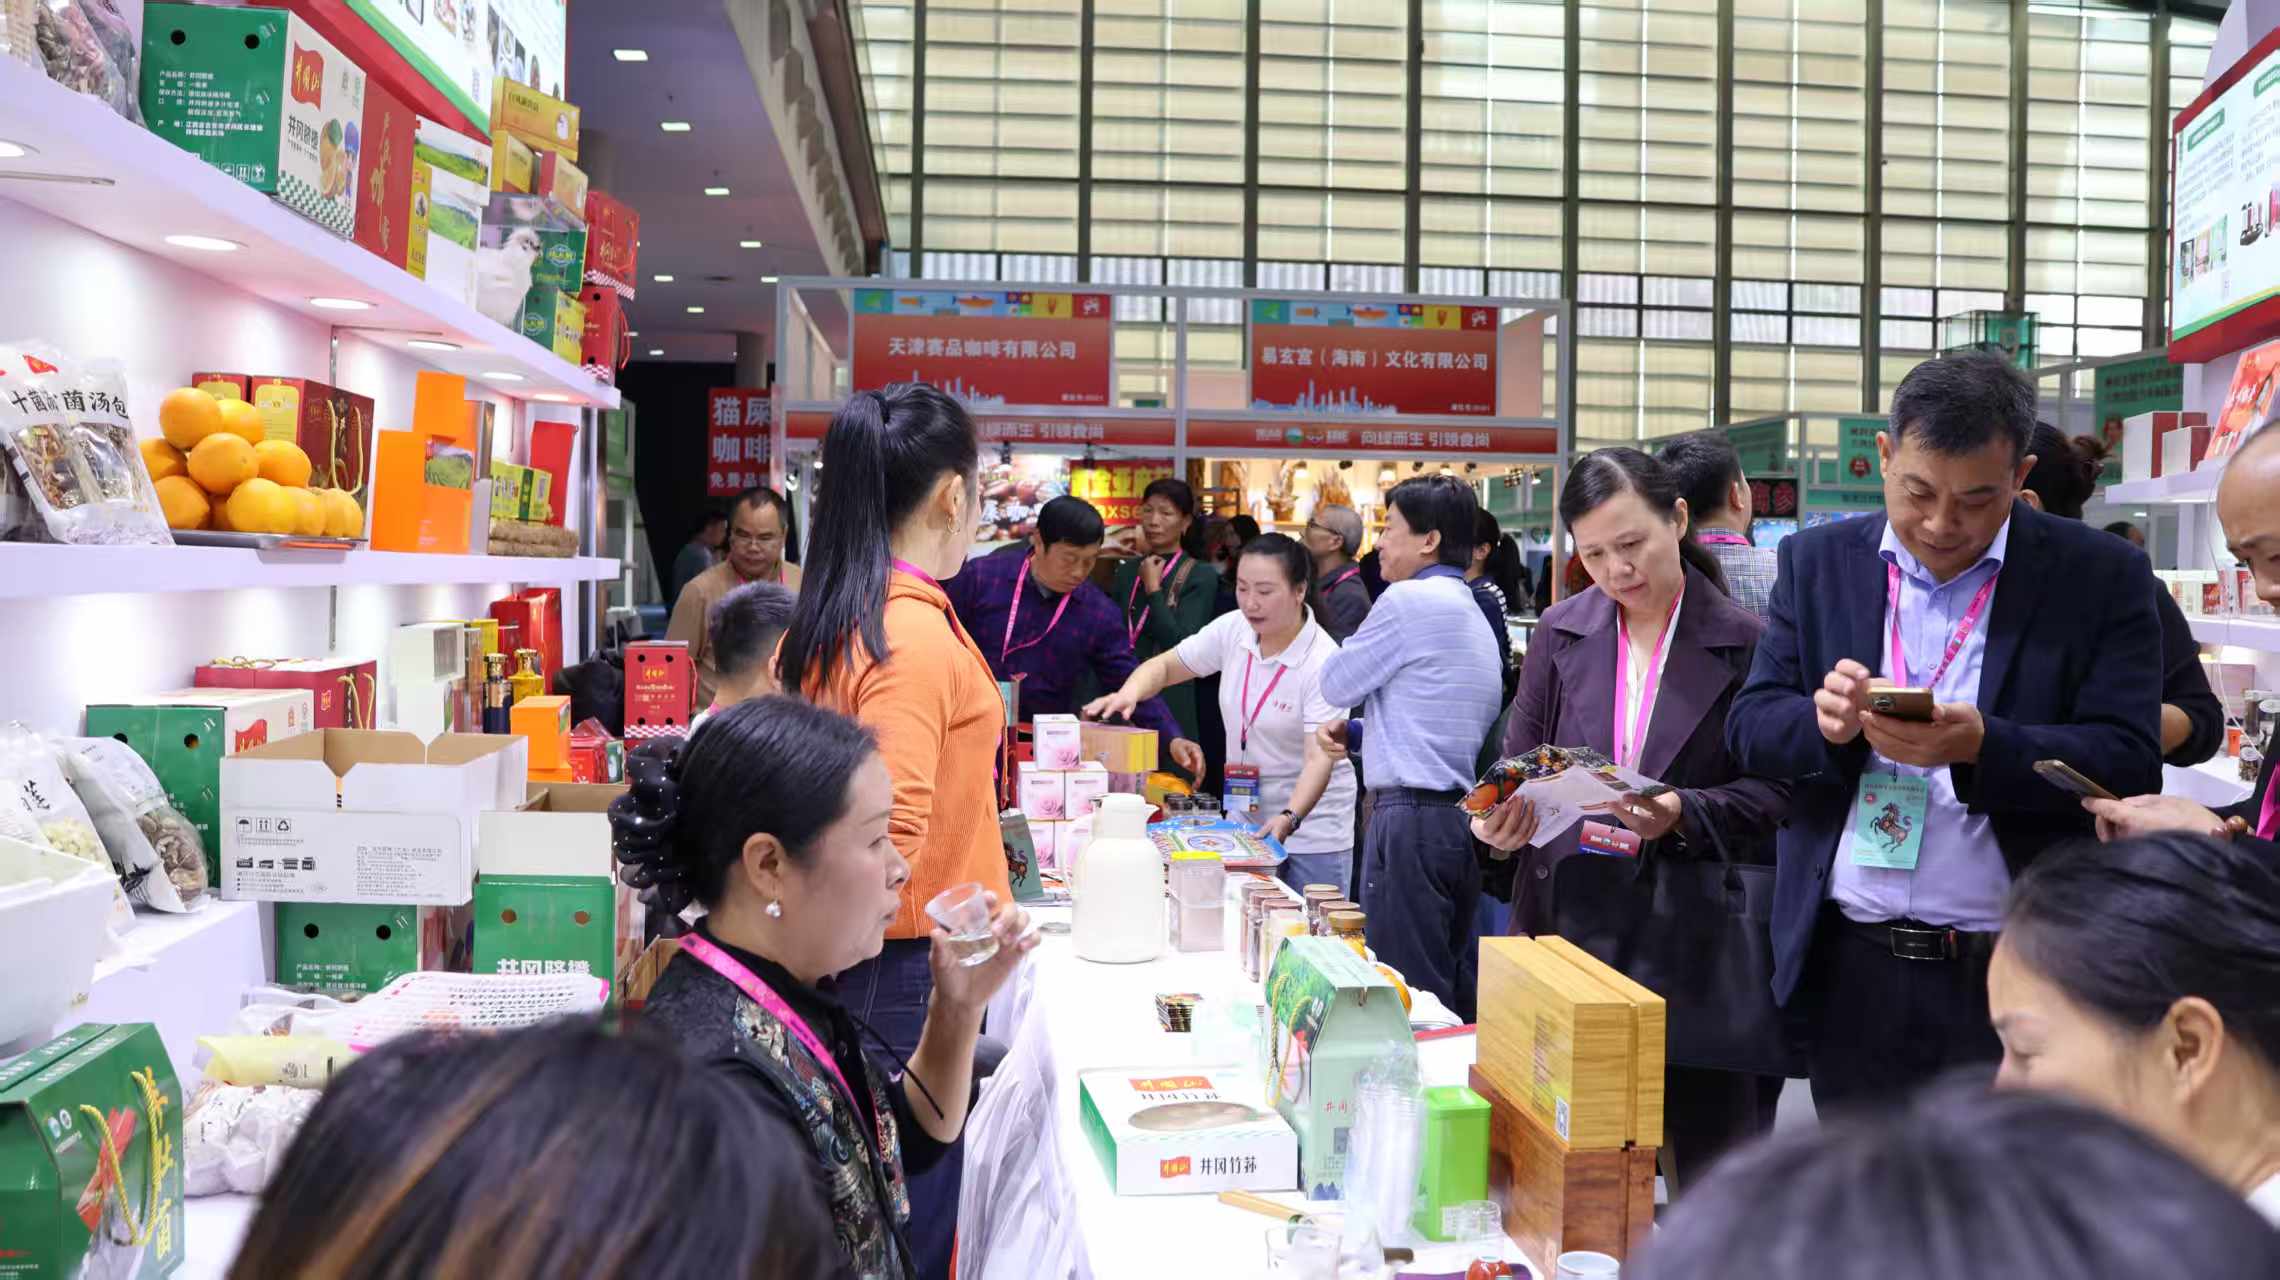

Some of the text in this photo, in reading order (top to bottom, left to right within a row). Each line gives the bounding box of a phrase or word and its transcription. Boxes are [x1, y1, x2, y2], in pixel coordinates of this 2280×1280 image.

[713, 434, 770, 464] 咖啡
[1200, 1157, 1257, 1176] 井冈竹荪
